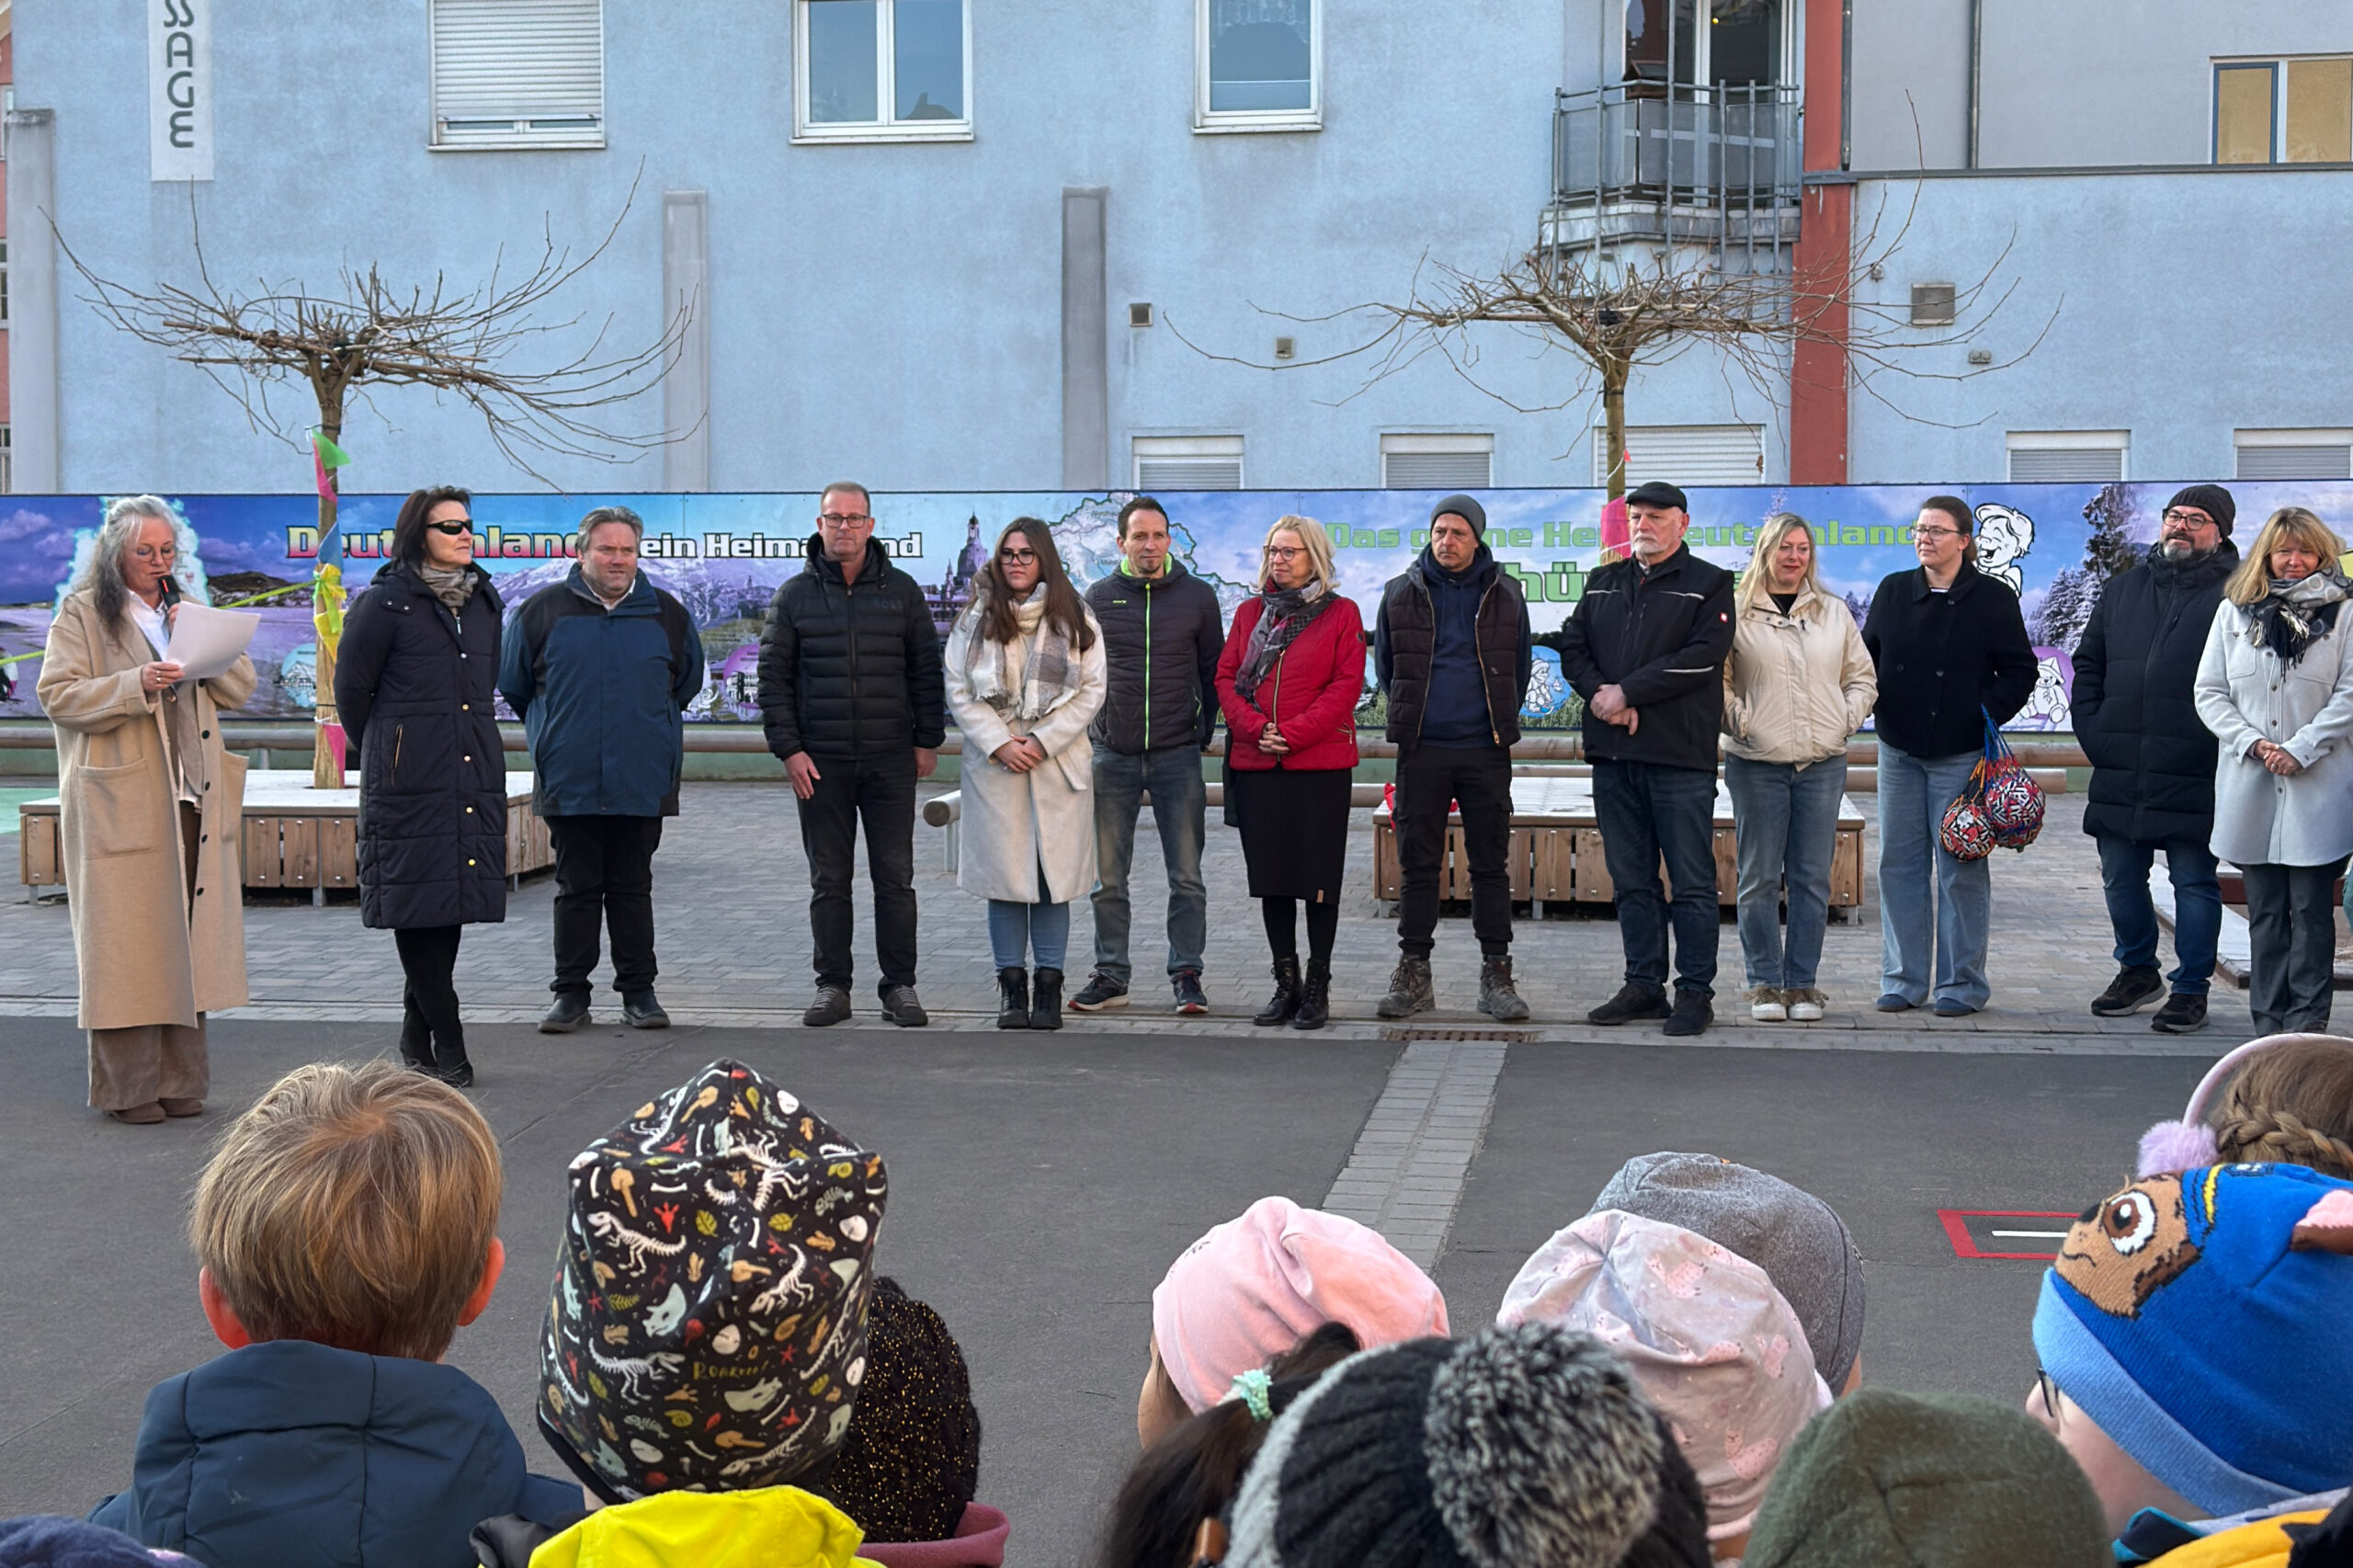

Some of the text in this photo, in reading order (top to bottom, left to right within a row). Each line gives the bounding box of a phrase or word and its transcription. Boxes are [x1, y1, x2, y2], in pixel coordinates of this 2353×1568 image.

[639, 532, 698, 559] ein
[703, 531, 923, 559] Heimnd
[1324, 522, 1400, 549] Das
[1410, 527, 1532, 554] gne
